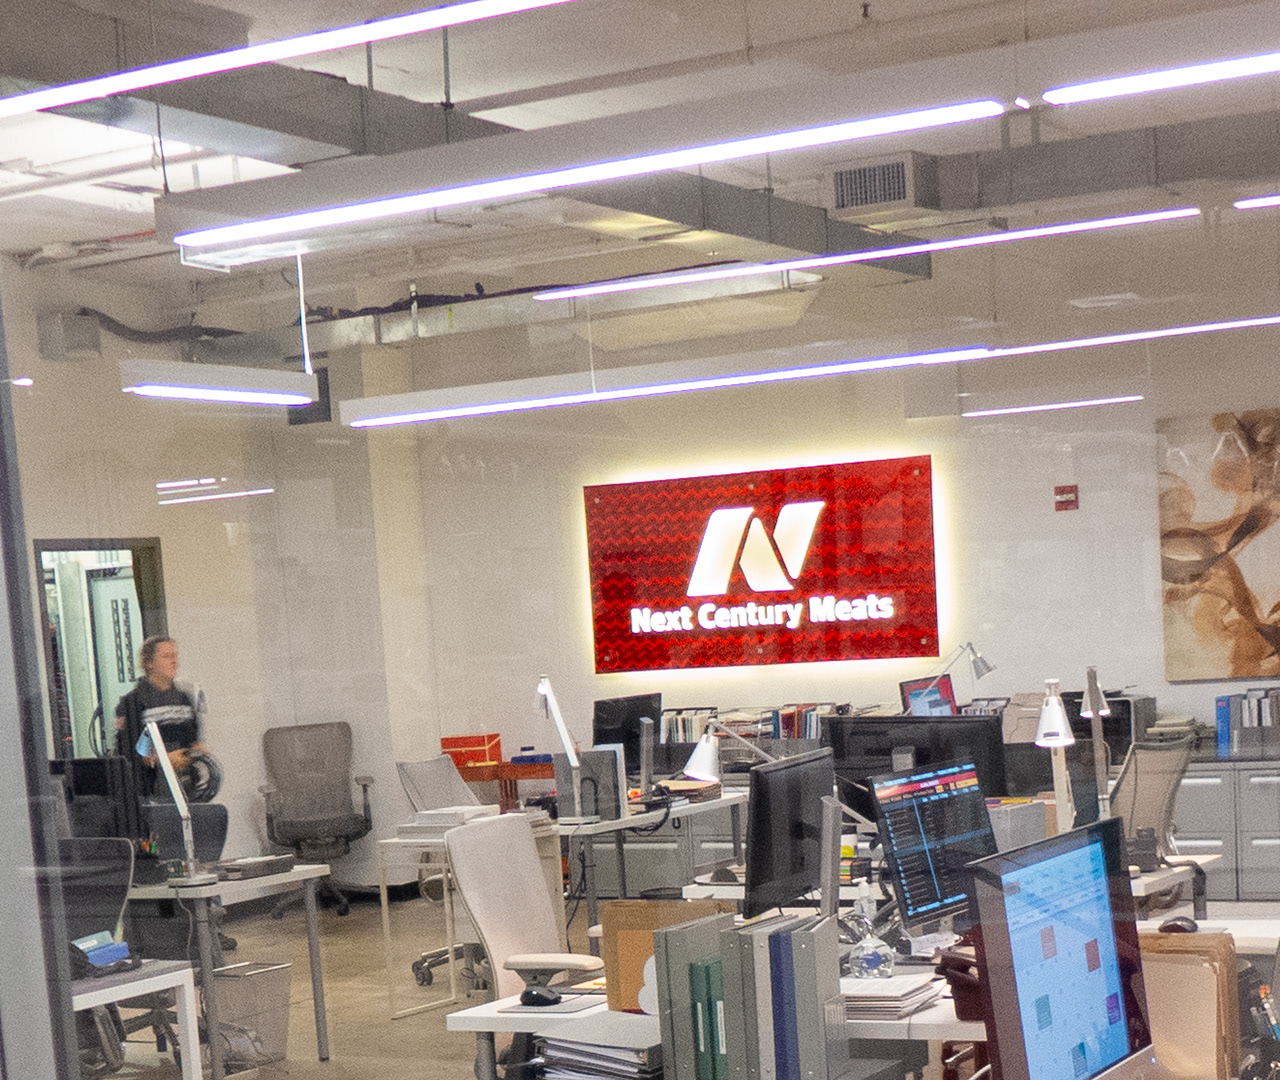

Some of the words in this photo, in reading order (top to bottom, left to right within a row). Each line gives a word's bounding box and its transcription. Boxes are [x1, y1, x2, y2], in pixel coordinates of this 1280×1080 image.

[630, 606, 693, 633] Next
[697, 602, 803, 630] Century
[809, 594, 894, 622] Meats
